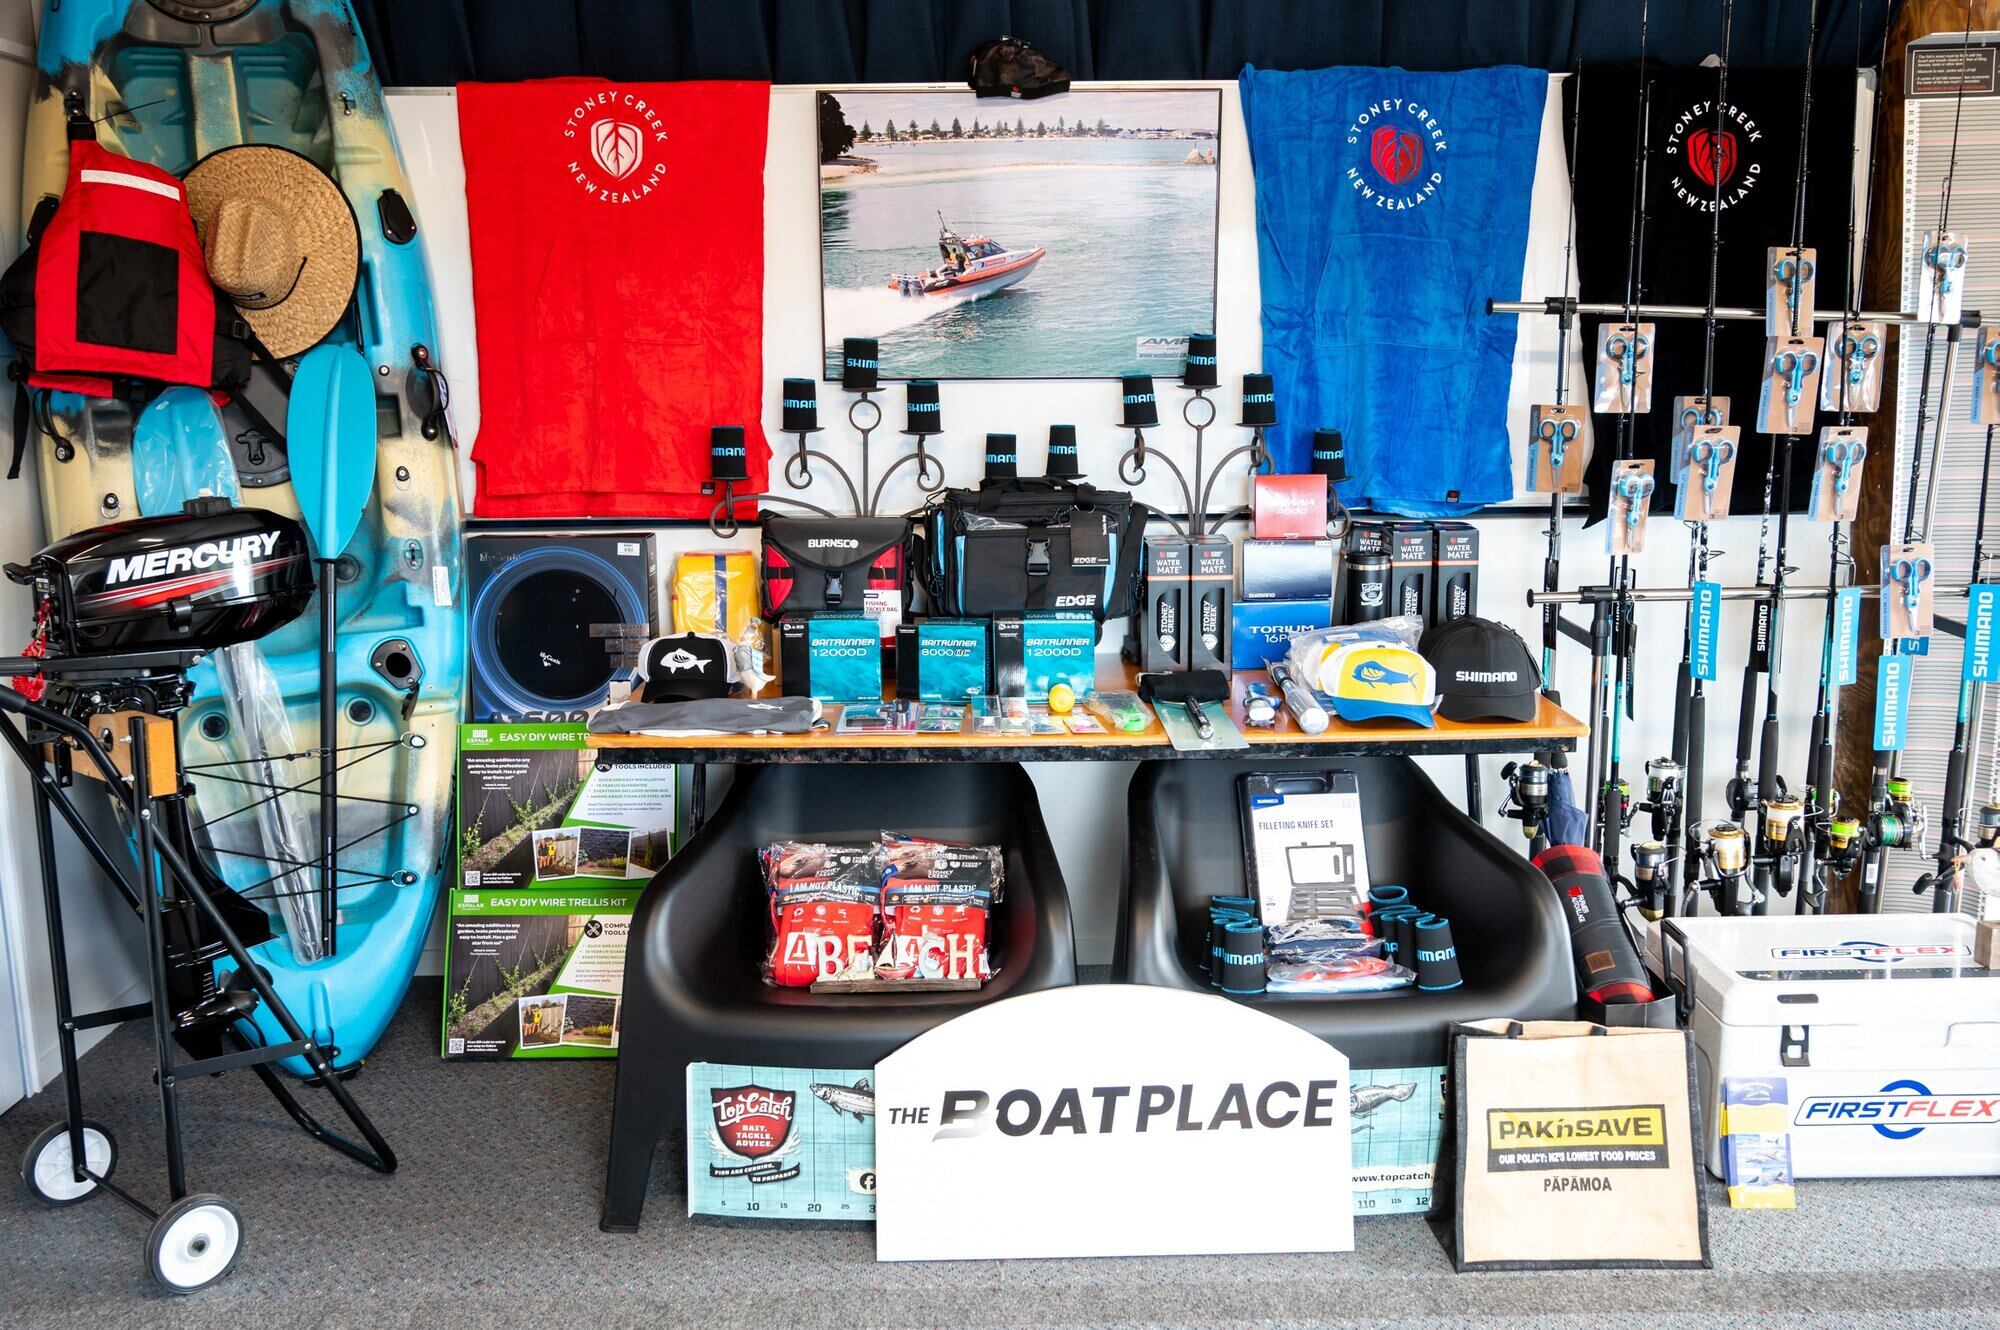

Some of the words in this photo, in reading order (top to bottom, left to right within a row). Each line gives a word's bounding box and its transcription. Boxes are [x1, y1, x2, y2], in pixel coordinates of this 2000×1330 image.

[564, 91, 617, 138] STONEY
[624, 94, 668, 142] CREEK
[1347, 99, 1403, 144] STONEY
[1408, 103, 1447, 152] CREEK
[1666, 101, 1711, 154] STONEY
[567, 161, 598, 194] NEW
[600, 163, 666, 204] ZEALAND
[1347, 167, 1375, 199] NEW
[1376, 172, 1442, 210] ZEALAND
[1672, 176, 1699, 207] NEW
[1700, 164, 1761, 212] ZEALAND
[807, 539, 859, 549] BURNSCO
[1401, 545, 1424, 553] WATER
[105, 530, 281, 585] MERCURY
[1200, 558, 1225, 566] WATER
[1055, 595, 1097, 607] EDGE
[1404, 586, 1412, 616] STONEY
[1453, 585, 1461, 615] STONEY
[1160, 601, 1168, 634] STONEY
[1248, 625, 1315, 634] TORIUM
[1698, 589, 1713, 677] SHIMANO
[1757, 605, 1769, 652] SHIMANO
[1973, 591, 1994, 678] SHIMANO
[811, 638, 875, 647] BAITRUNNER
[921, 639, 977, 647] BAITRUNNER
[1026, 638, 1090, 646] BAITRUNNER
[1839, 595, 1853, 682] SHIMANO
[812, 648, 867, 657] 12000D
[1027, 648, 1082, 657] 12000D
[1456, 671, 1518, 683] SHIMANO
[1883, 663, 1900, 747] SHIMANO
[500, 733, 528, 742] EASY
[529, 733, 547, 742] DIY
[549, 733, 575, 742] WIRE
[1258, 820, 1296, 830] FILLETING
[1297, 820, 1319, 829] KNIFE
[1320, 819, 1334, 829] SET
[793, 883, 808, 892] AM
[809, 881, 826, 891] NOT
[826, 881, 861, 896] PLASTIC
[907, 885, 922, 893] AM
[924, 884, 940, 892] NOT
[943, 884, 977, 893] PLASTIC
[491, 898, 519, 907] EASY
[520, 898, 538, 907] DIY
[540, 898, 567, 907] WIRE
[568, 898, 609, 907] TRELLIS
[610, 898, 627, 907] KIT
[1781, 946, 1955, 957] FIRSTFLEX
[1805, 1099, 2000, 1119] FIRSTFLEX
[888, 1106, 930, 1125] THE
[742, 1124, 768, 1132] BAIT.
[736, 1132, 774, 1140] TACKLE.
[1499, 1154, 1516, 1165] OUR
[1517, 1153, 1548, 1163] POLICY:
[1549, 1152, 1566, 1163] NZ'S
[1567, 1151, 1599, 1162] LOWEST
[1601, 1150, 1624, 1162] FOOD
[1625, 1150, 1656, 1161] PRICES
[744, 1164, 775, 1173] CUNNING.
[761, 1170, 798, 1182] PREPARED.
[1543, 1175, 1612, 1192] PĀPĀMOA
[746, 1203, 760, 1211] 10
[808, 1204, 822, 1213] 20
[1358, 1199, 1376, 1209] 110
